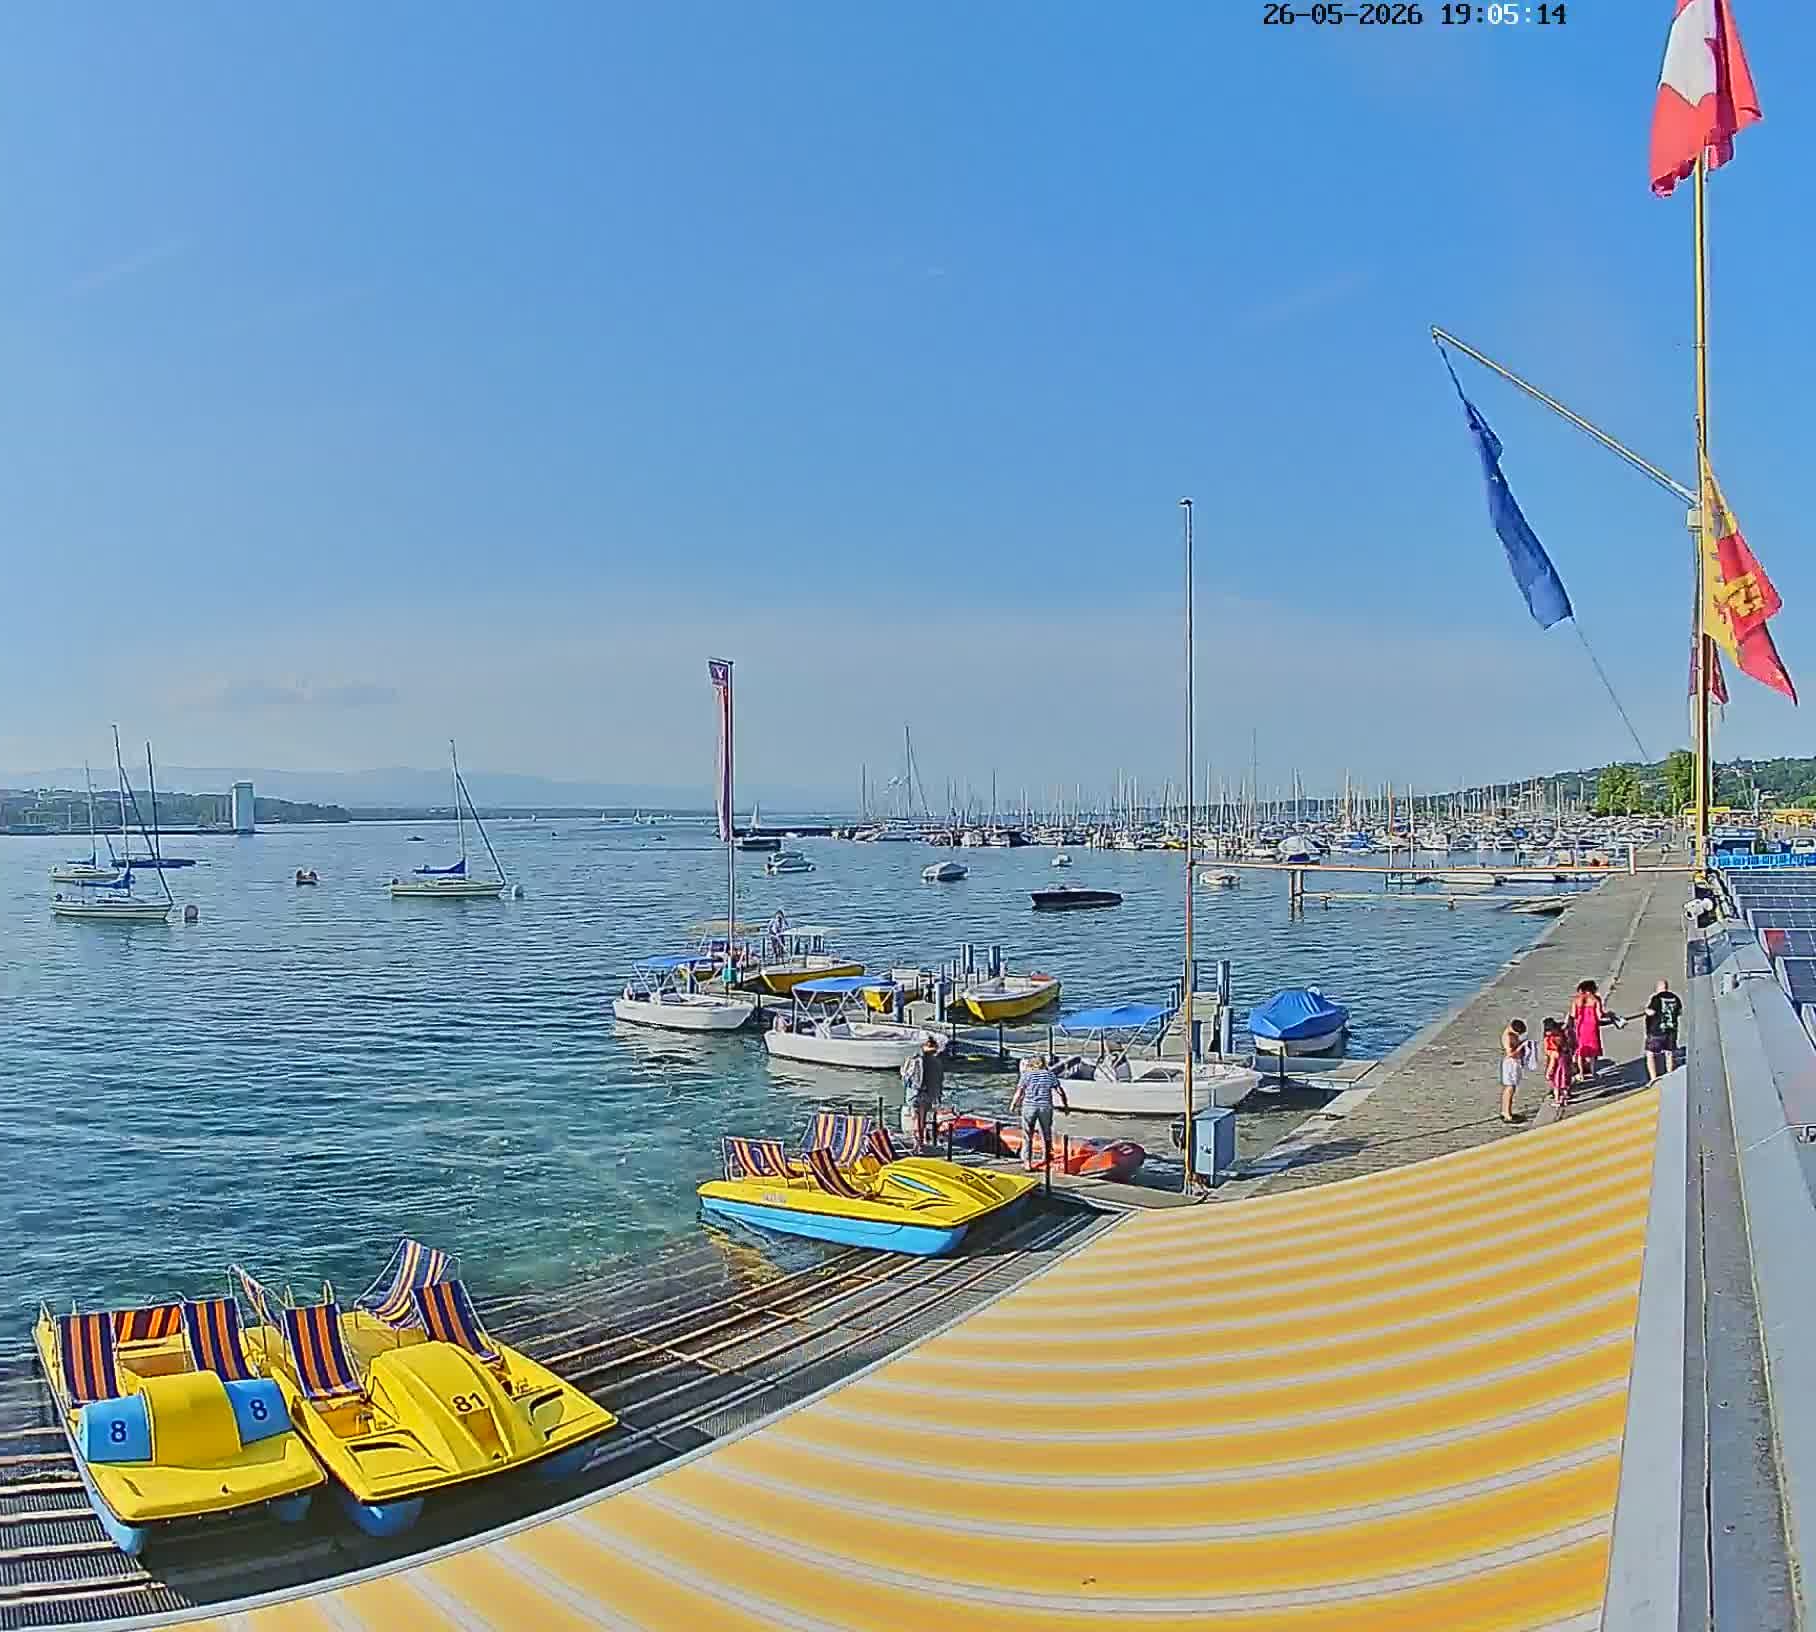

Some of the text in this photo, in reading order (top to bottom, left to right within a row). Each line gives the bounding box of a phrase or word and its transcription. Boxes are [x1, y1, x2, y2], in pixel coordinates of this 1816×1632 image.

[249, 1399, 268, 1421] 8
[452, 1392, 486, 1412] 81
[110, 1419, 127, 1443] 8
